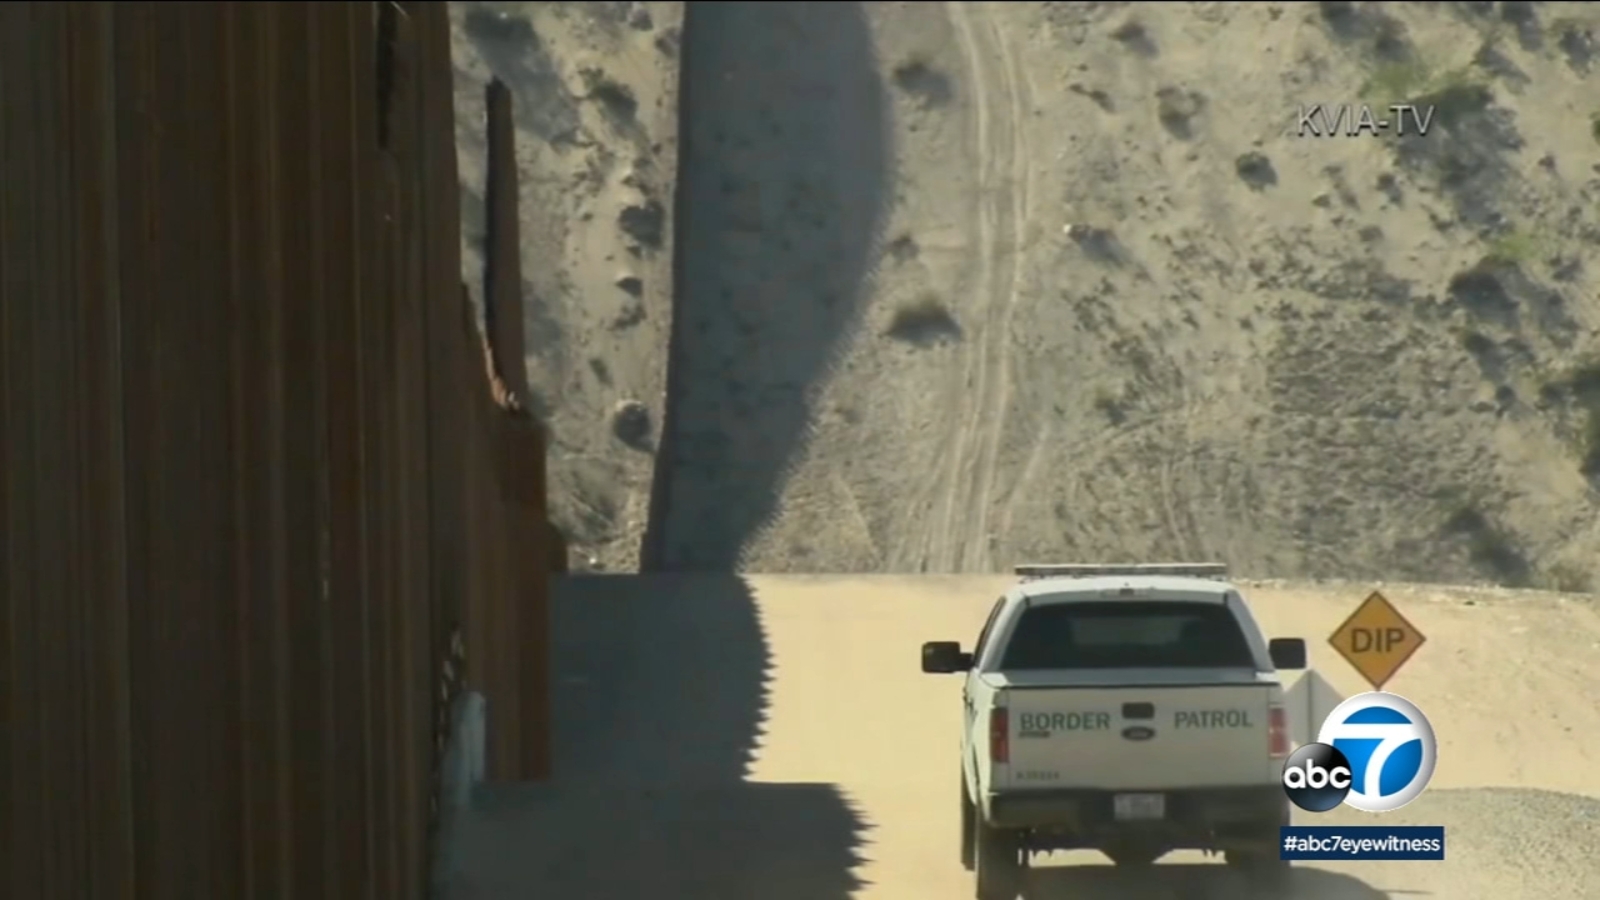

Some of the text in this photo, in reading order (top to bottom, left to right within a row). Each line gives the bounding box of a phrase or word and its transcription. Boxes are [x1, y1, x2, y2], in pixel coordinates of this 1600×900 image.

[1351, 628, 1405, 653] DIP
[1019, 709, 1254, 731] BORDER PATROL
